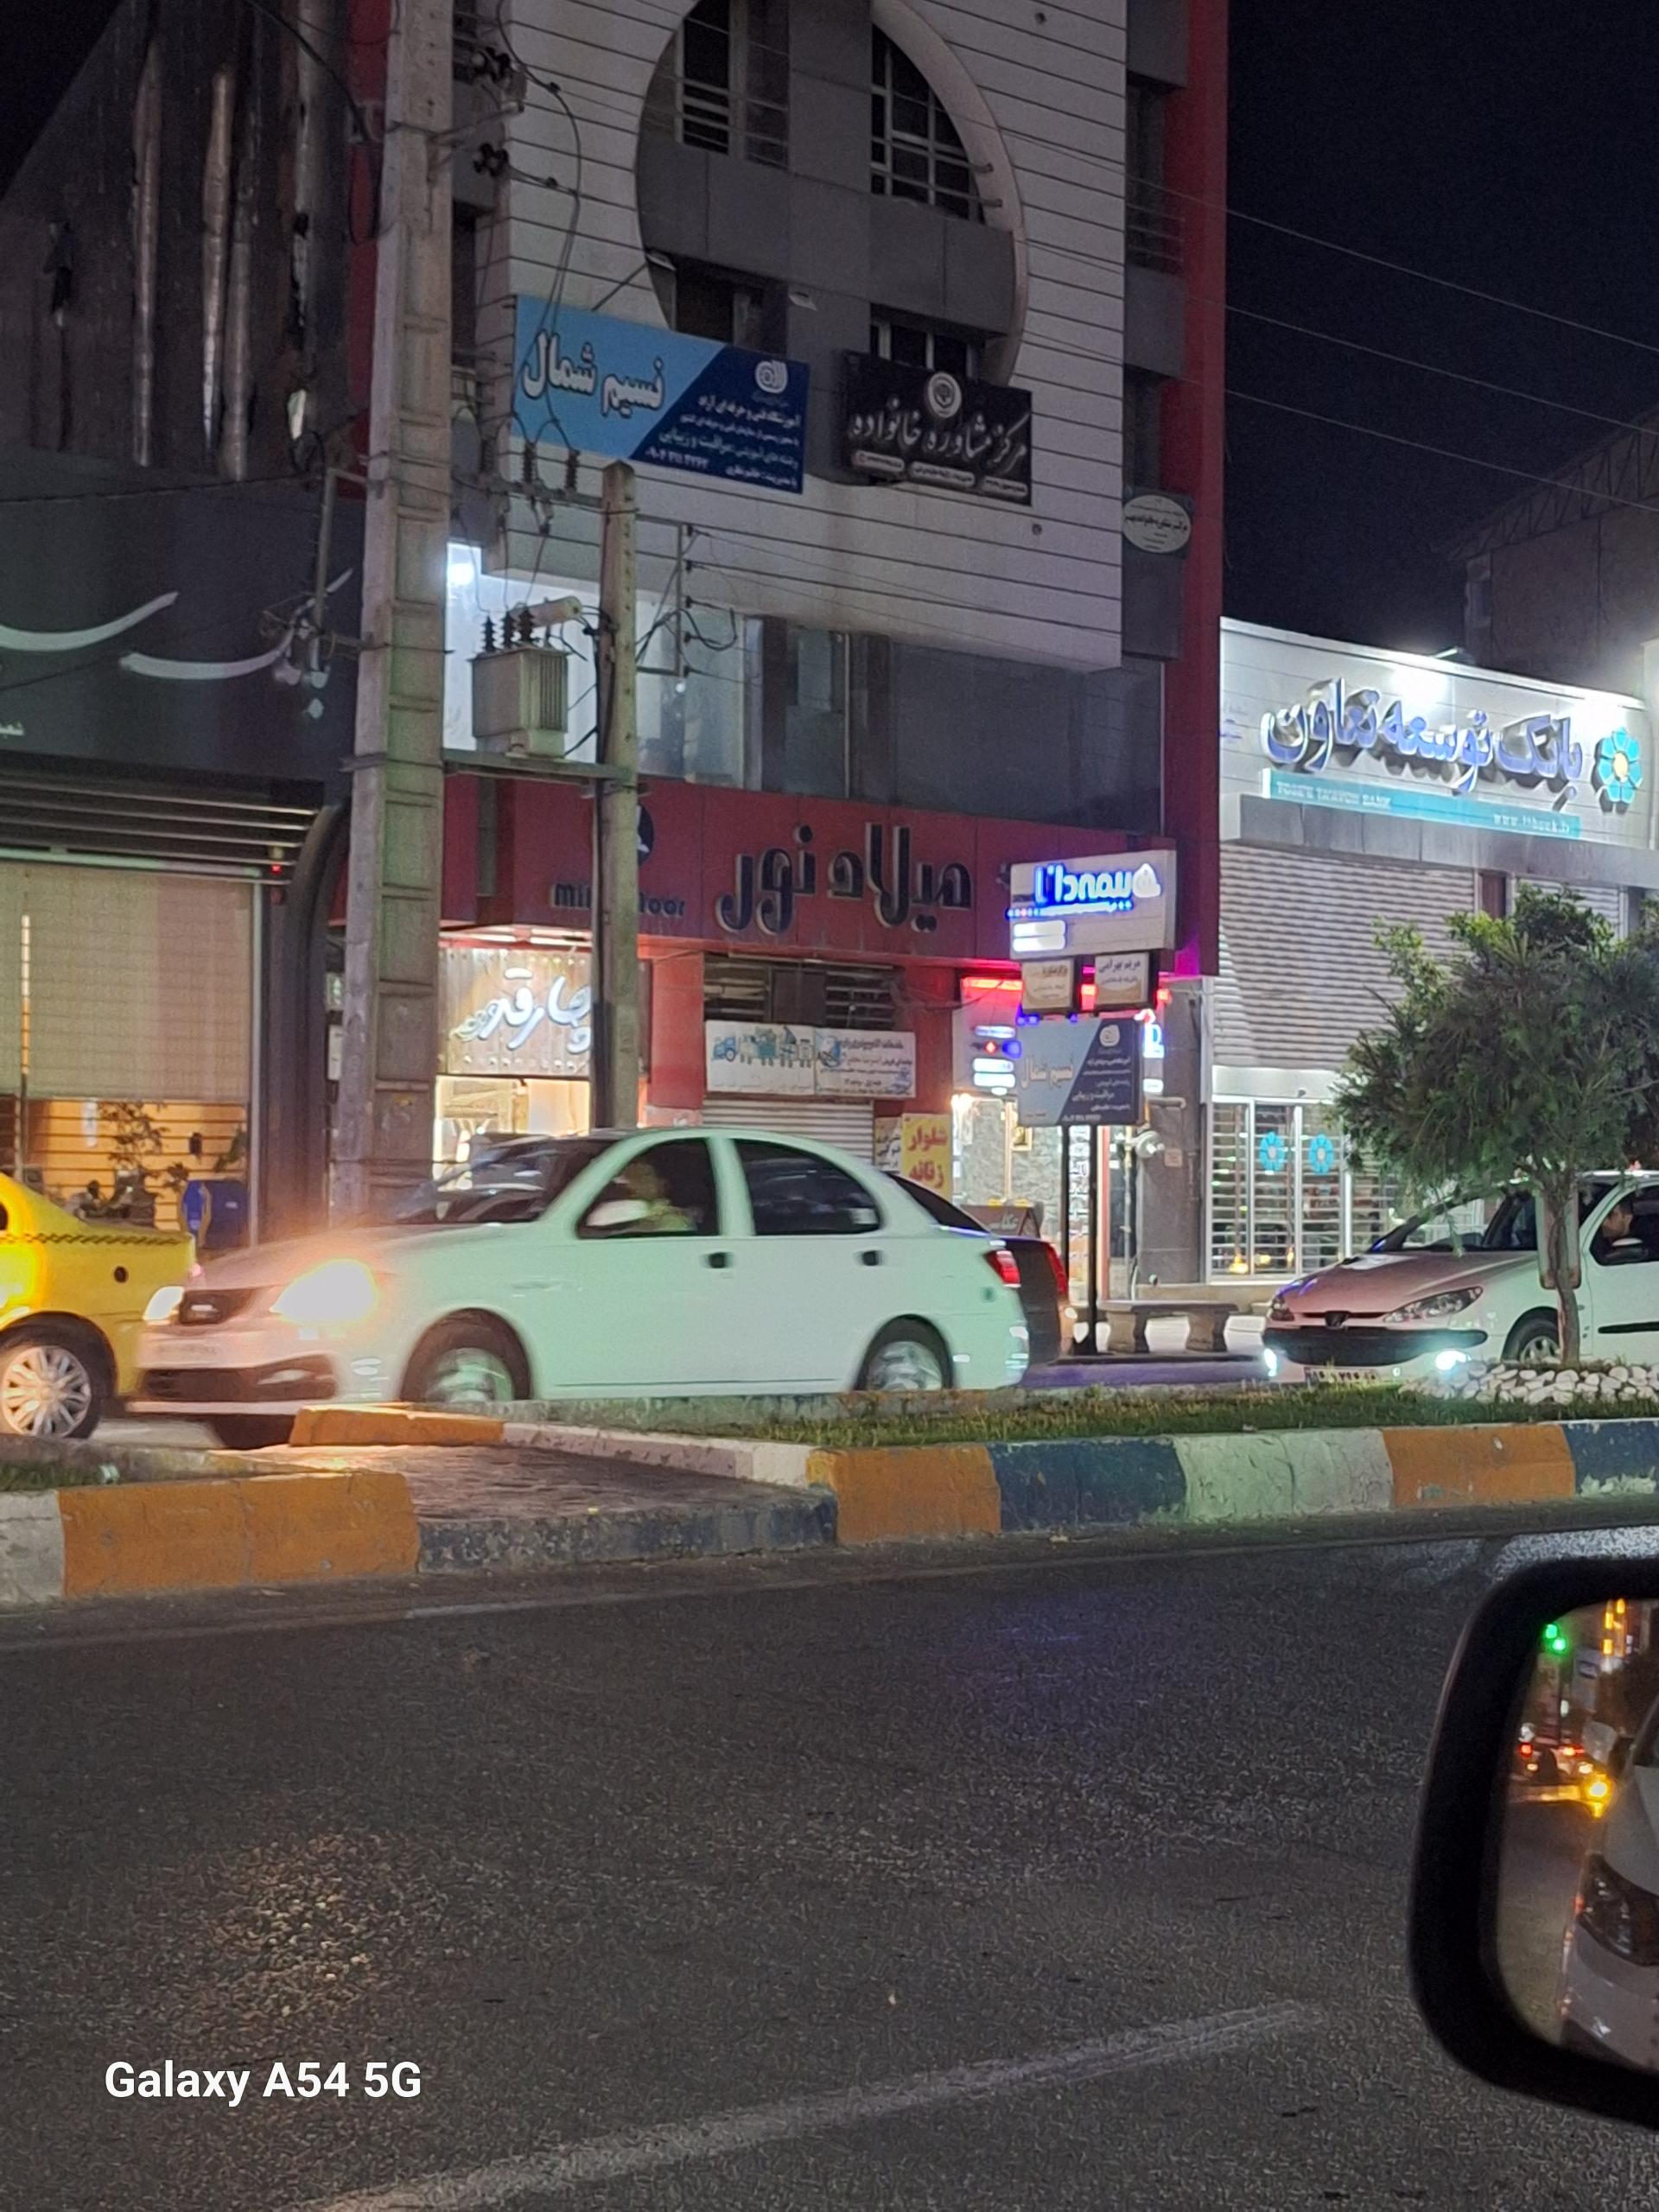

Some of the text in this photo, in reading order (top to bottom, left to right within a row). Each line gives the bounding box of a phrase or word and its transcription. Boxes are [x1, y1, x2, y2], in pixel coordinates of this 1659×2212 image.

[521, 329, 664, 419] نسیم شمال
[850, 397, 922, 446] خانواده
[925, 413, 992, 460] مشاوره
[988, 410, 1032, 474] مرکز
[0, 721, 25, 740] شعب
[1260, 677, 1382, 772] تعاون
[1382, 700, 1495, 794] توسعه
[1497, 712, 1584, 804] بانک
[1362, 792, 1392, 810] BANK
[715, 821, 973, 936] میلاد نور
[1020, 1053, 1075, 1090] نسیم شمال
[906, 1124, 949, 1153] شلوار
[907, 1158, 945, 1190] زنانه
